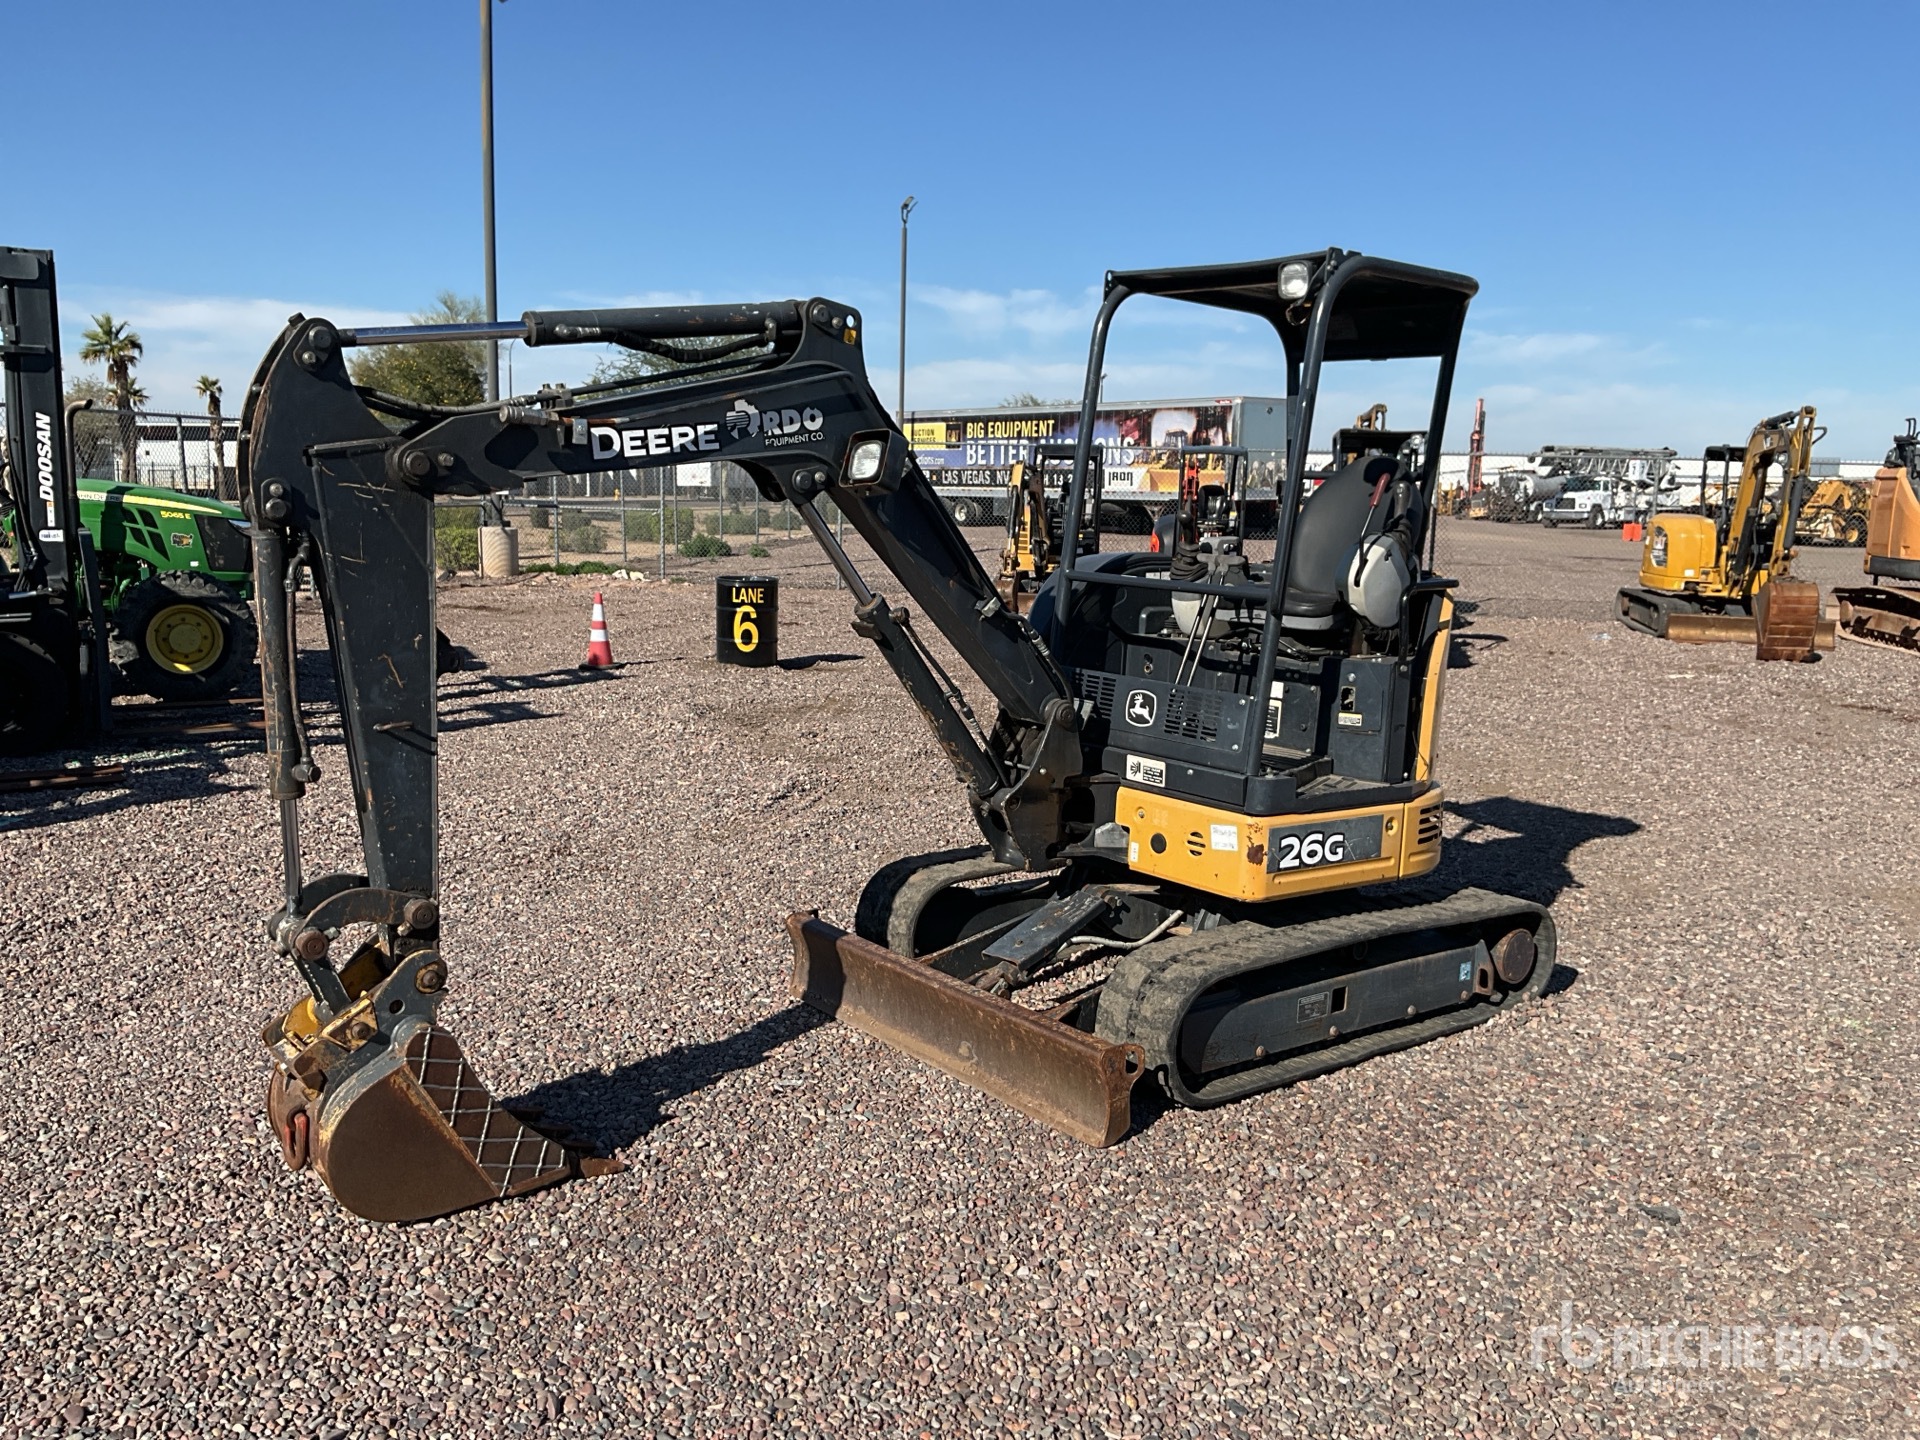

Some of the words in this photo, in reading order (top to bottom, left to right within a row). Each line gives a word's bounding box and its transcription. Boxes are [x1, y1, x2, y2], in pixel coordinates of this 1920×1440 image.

[762, 407, 824, 436] RDO
[913, 428, 935, 436] UCTION
[966, 423, 985, 439] BIG
[987, 420, 1055, 438] EQUIPMENT
[590, 424, 720, 460] DEERE
[765, 434, 809, 447] EQUIPMENT
[966, 439, 1029, 466] BETTER
[35, 411, 54, 502] DOOSAN
[942, 470, 959, 484] LAS
[996, 471, 1009, 484] NV
[732, 587, 765, 604] LANE
[733, 605, 759, 653] 6
[1279, 833, 1344, 869] 26G
